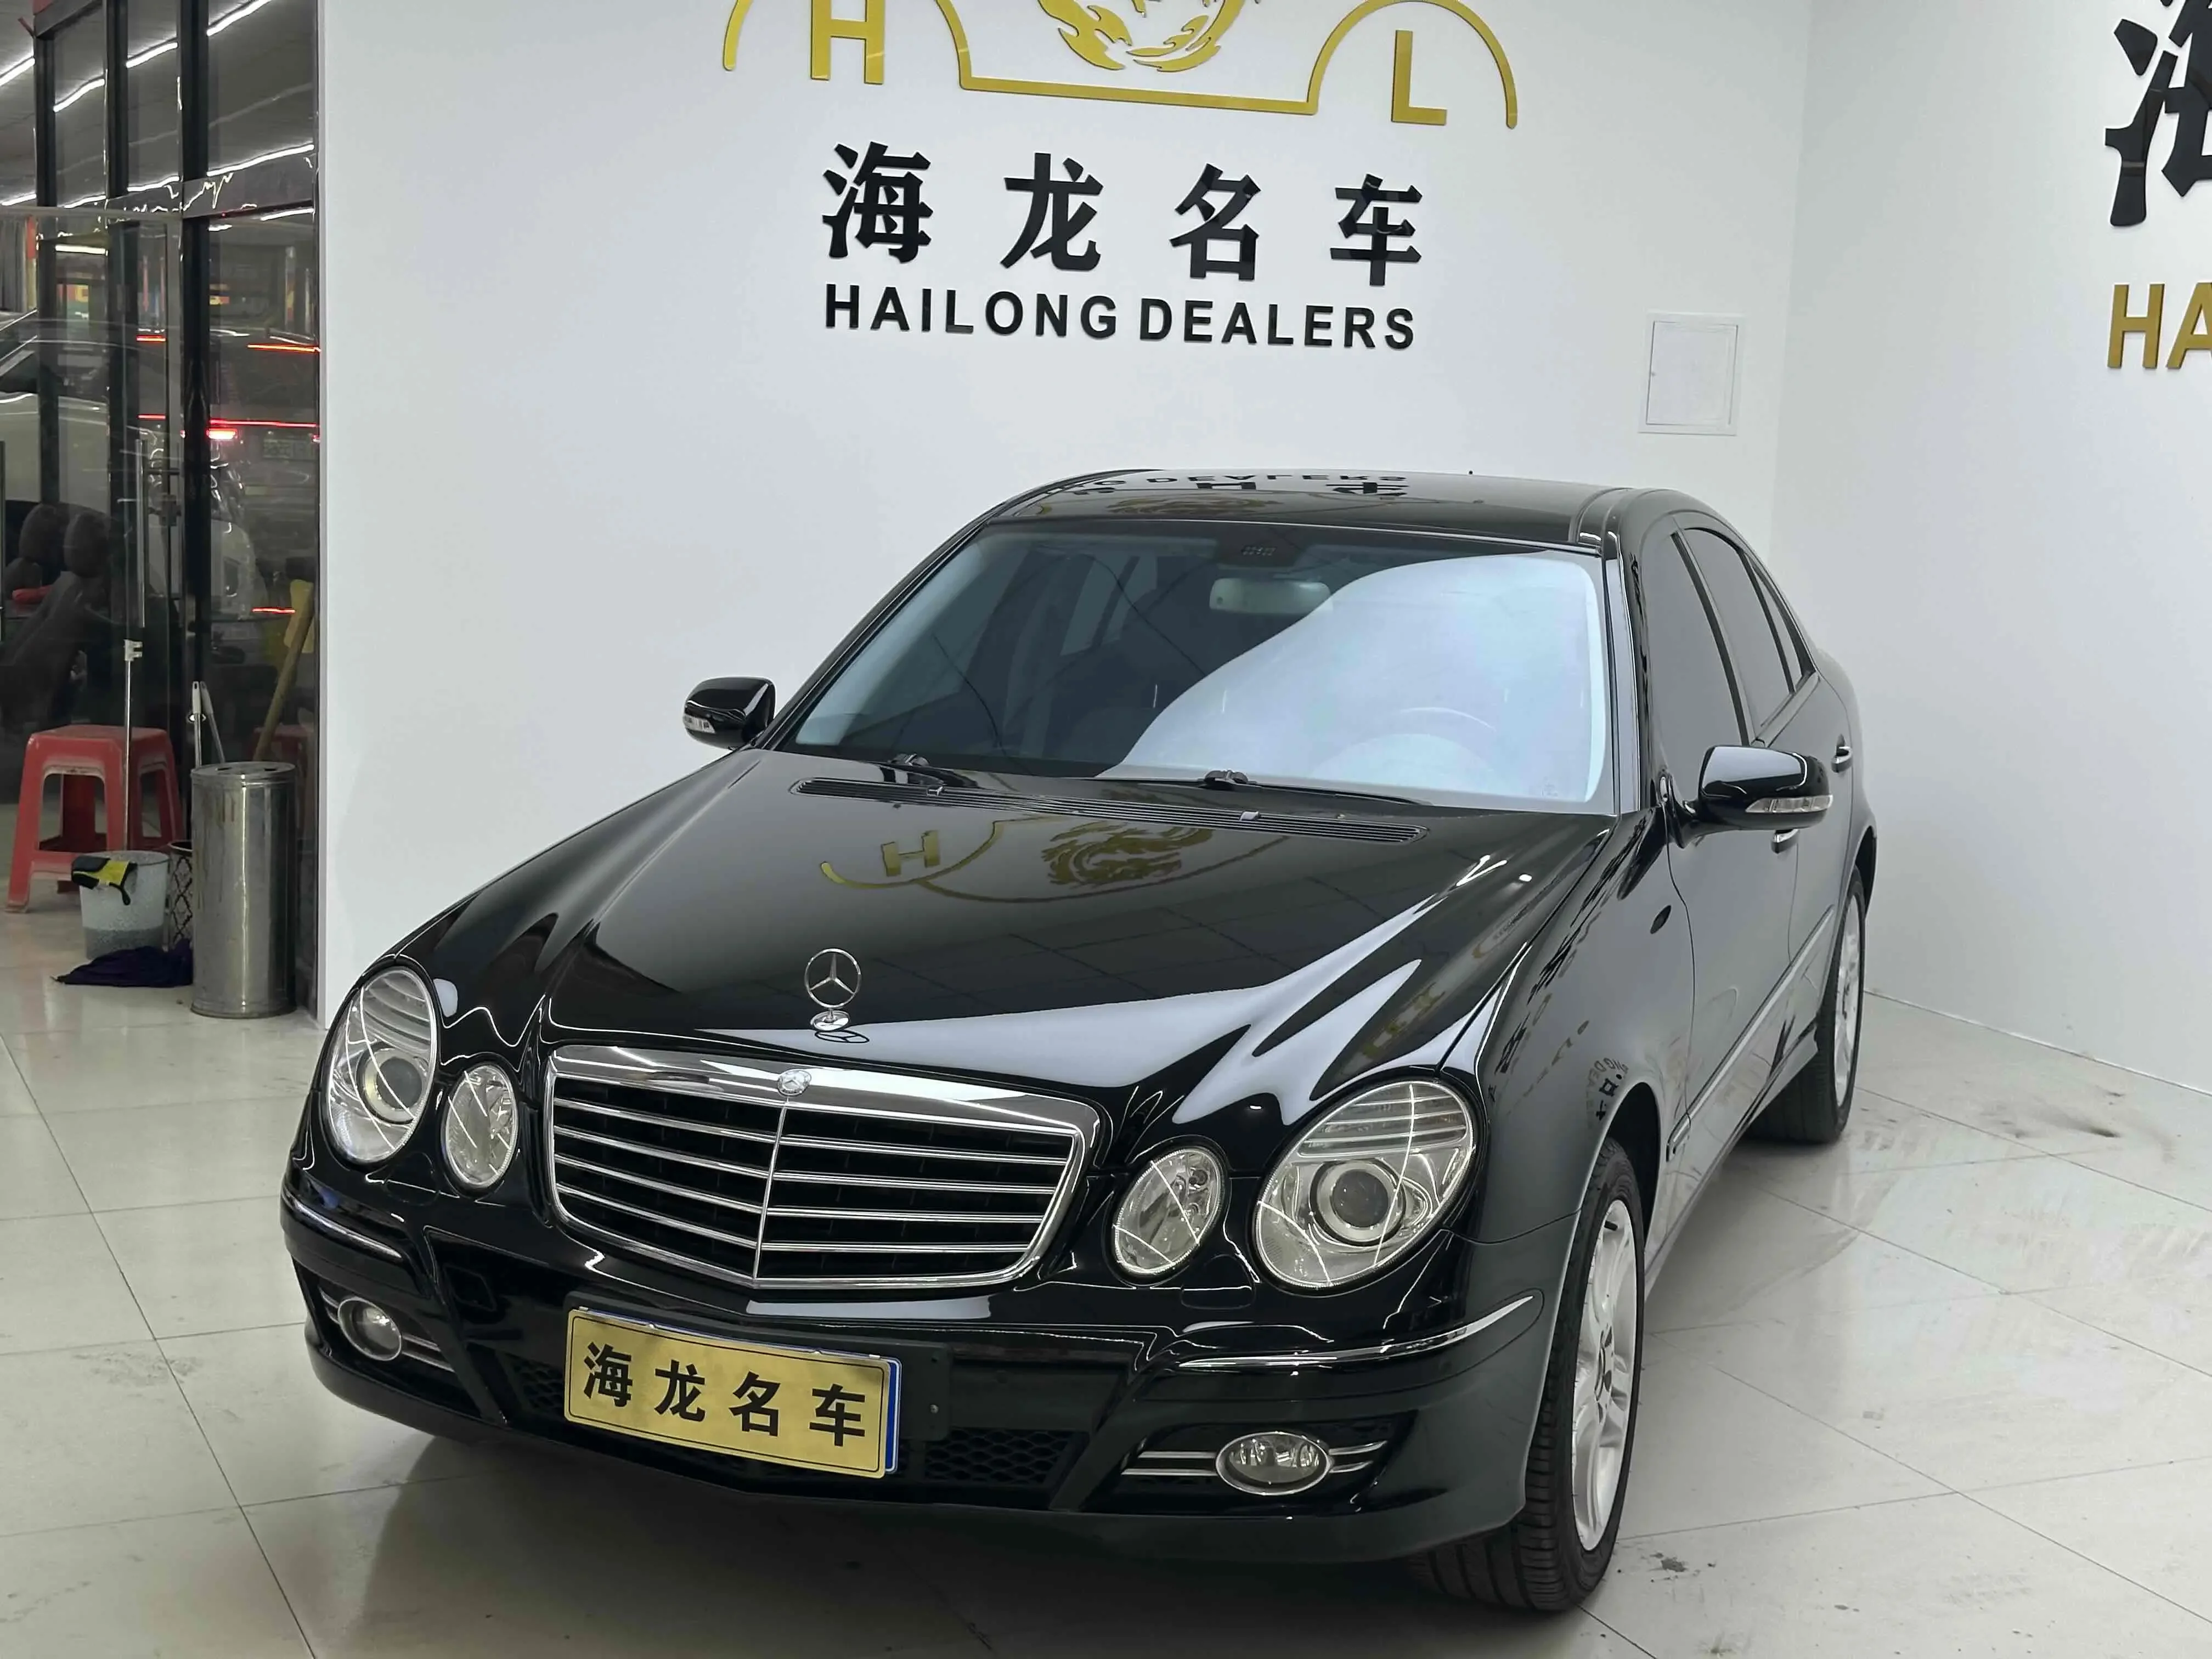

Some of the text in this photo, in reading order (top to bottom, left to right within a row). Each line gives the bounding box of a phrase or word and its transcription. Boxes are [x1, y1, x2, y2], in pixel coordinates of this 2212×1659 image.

[810, 0, 1448, 126] H L
[822, 141, 1423, 286] 海龙名车
[825, 283, 1414, 350] HAILONG DEALERS
[583, 1341, 866, 1447] 海龙名车
